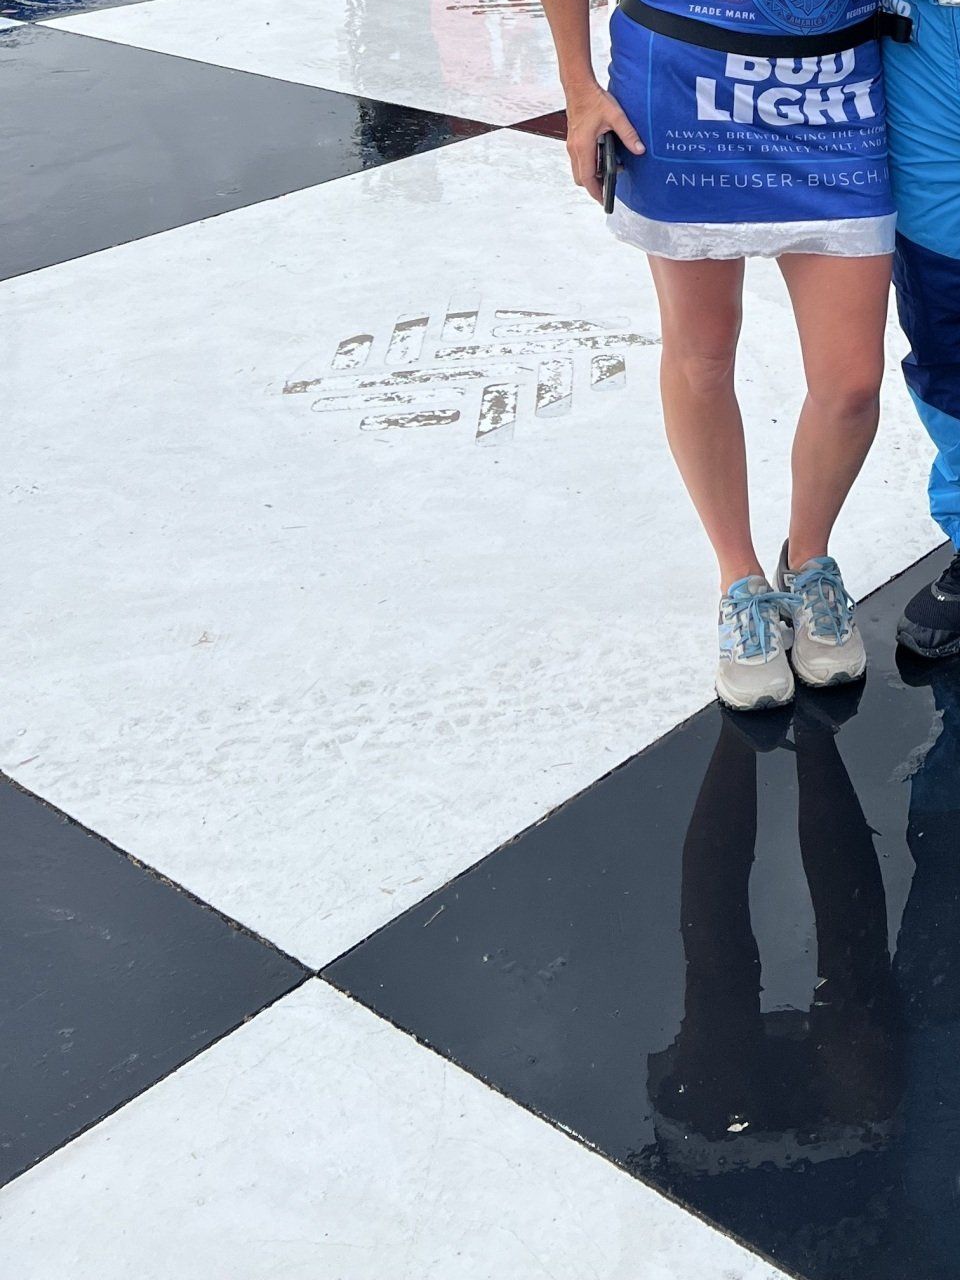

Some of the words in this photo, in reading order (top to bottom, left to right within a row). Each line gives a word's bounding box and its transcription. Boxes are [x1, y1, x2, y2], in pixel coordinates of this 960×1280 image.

[689, 4, 722, 17] TRADE
[725, 9, 756, 21] MARK
[725, 48, 855, 85] BUD
[695, 76, 876, 126] LIGHT
[665, 129, 720, 139] ALWAYS
[726, 131, 780, 141] BREWED
[785, 131, 826, 141] USING
[831, 129, 855, 139] THE
[666, 142, 712, 153] HOPS,
[717, 143, 754, 152] BEST
[760, 144, 811, 153] BARLEY
[861, 138, 881, 148] AND
